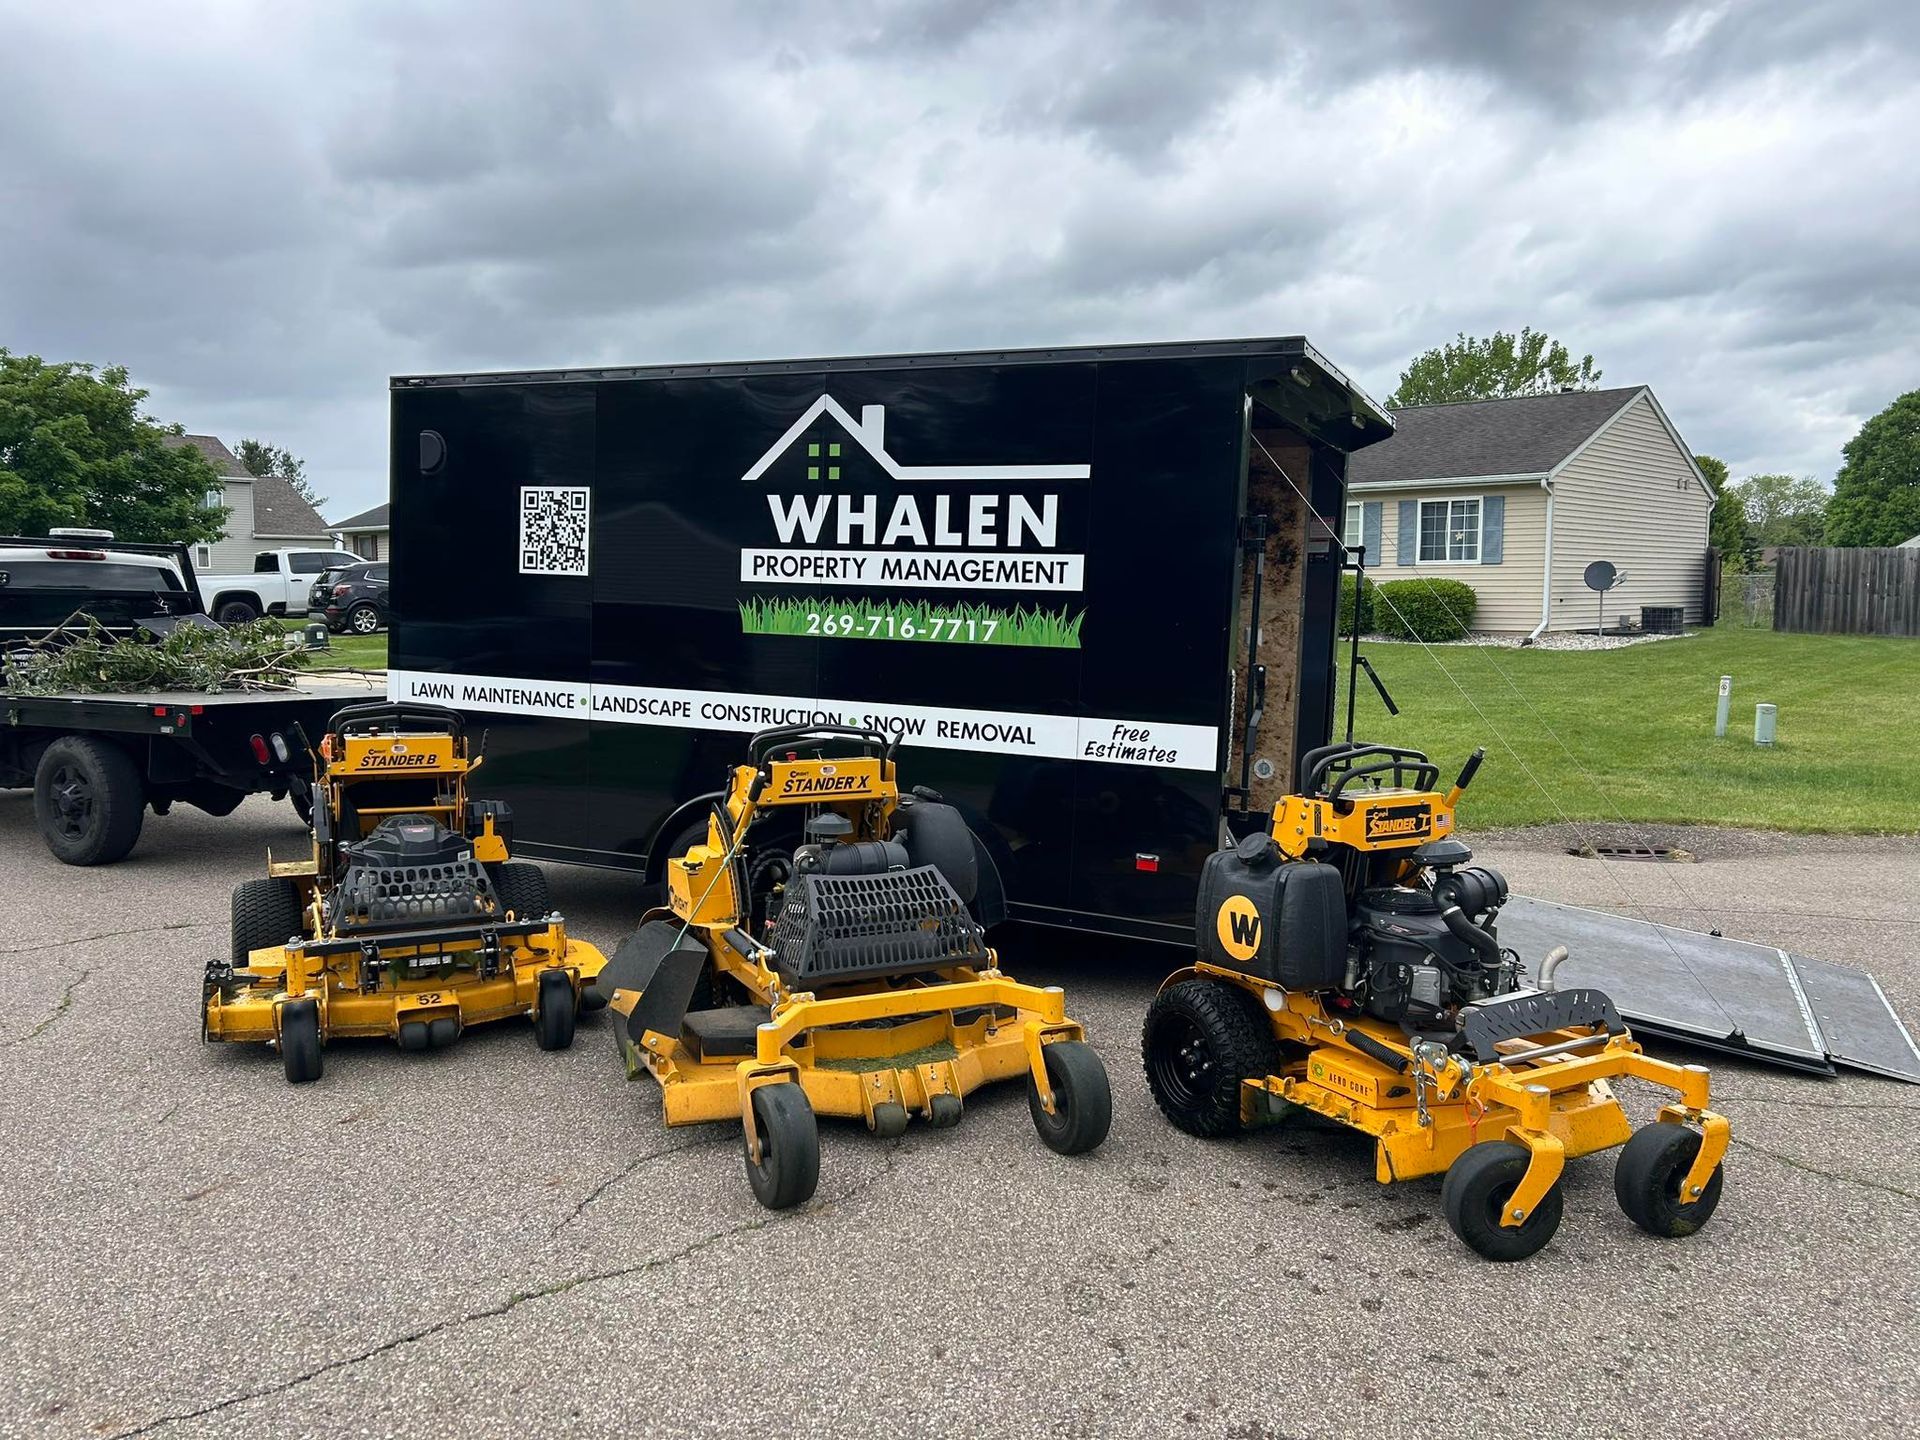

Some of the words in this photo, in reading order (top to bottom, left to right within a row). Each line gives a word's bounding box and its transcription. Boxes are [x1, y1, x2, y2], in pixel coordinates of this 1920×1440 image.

[767, 494, 1058, 548] WHALEN
[752, 555, 867, 579] PROPERTY
[880, 558, 1069, 584] MANAGEMENT
[806, 613, 998, 642] 269-716-7717
[411, 681, 455, 700] LAWN
[462, 685, 575, 709] MAINTENANCE
[592, 695, 691, 718] LANDSCAPE
[701, 702, 842, 726] CONSTRUCTION
[863, 714, 927, 737] SNOW
[937, 721, 1036, 745] REMOVAL
[1112, 724, 1151, 743] Free
[360, 754, 425, 767] STANDER
[427, 753, 438, 765] B
[1084, 741, 1178, 764] Estimates
[783, 776, 855, 793] STANDER
[857, 775, 870, 789] X
[1369, 817, 1417, 836] STANDER
[1229, 911, 1260, 948] W
[419, 993, 442, 1005] 52
[1328, 1072, 1347, 1088] AERO
[1349, 1080, 1368, 1097] CORE
